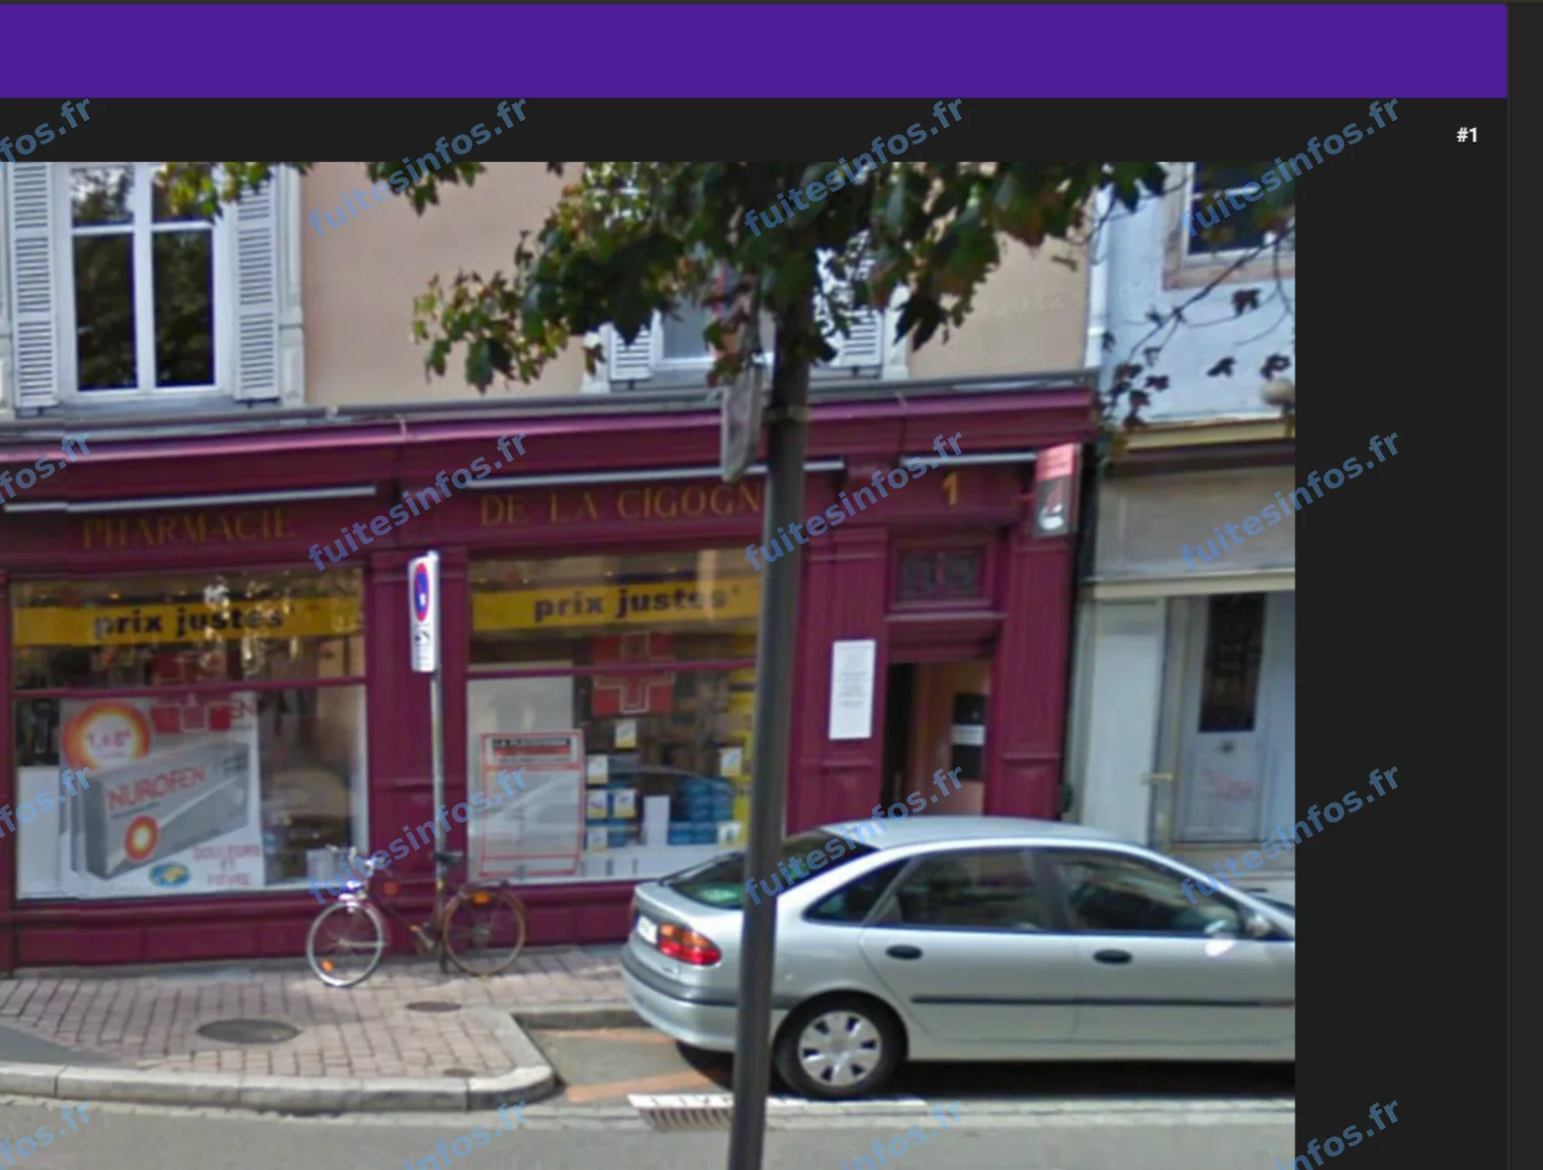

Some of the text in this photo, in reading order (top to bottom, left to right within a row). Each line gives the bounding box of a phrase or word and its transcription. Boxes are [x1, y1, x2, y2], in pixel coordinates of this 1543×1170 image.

[1455, 126, 1479, 144] #1
[479, 484, 763, 526] DE LA CIGOGN
[941, 471, 961, 506] 1
[83, 508, 297, 549] PHARMACIE
[534, 590, 604, 623] prix
[93, 608, 164, 641] prix
[107, 765, 207, 810] NUROFEN
